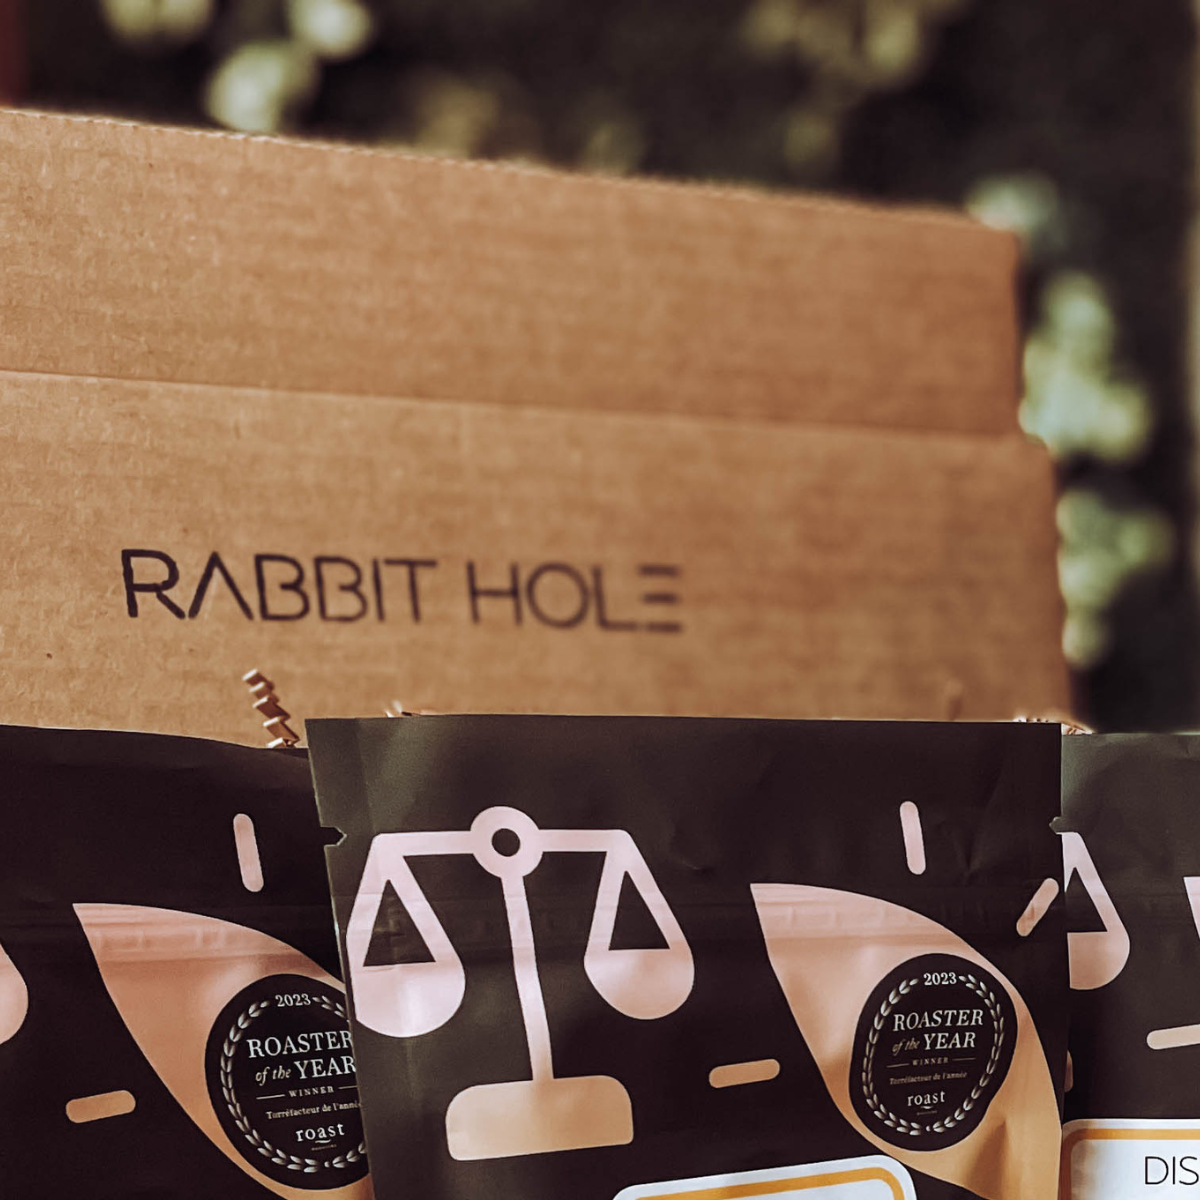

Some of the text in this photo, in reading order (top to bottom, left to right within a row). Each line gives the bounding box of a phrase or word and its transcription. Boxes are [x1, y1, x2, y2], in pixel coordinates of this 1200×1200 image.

[121, 548, 684, 634] RABBIT HOLE
[923, 972, 957, 986] 2023
[275, 993, 312, 1007] 2023
[892, 1009, 984, 1031] ROASTER
[247, 1030, 353, 1058] ROASTER
[892, 1032, 976, 1056] of the YEAR
[912, 1057, 949, 1066] WINNER
[255, 1055, 356, 1086] of the YEAR
[289, 1086, 334, 1098] WINNER
[907, 1091, 945, 1106] roast
[266, 1105, 320, 1119] Torréfacteur
[322, 1104, 332, 1112] de
[296, 1123, 345, 1142] roast
